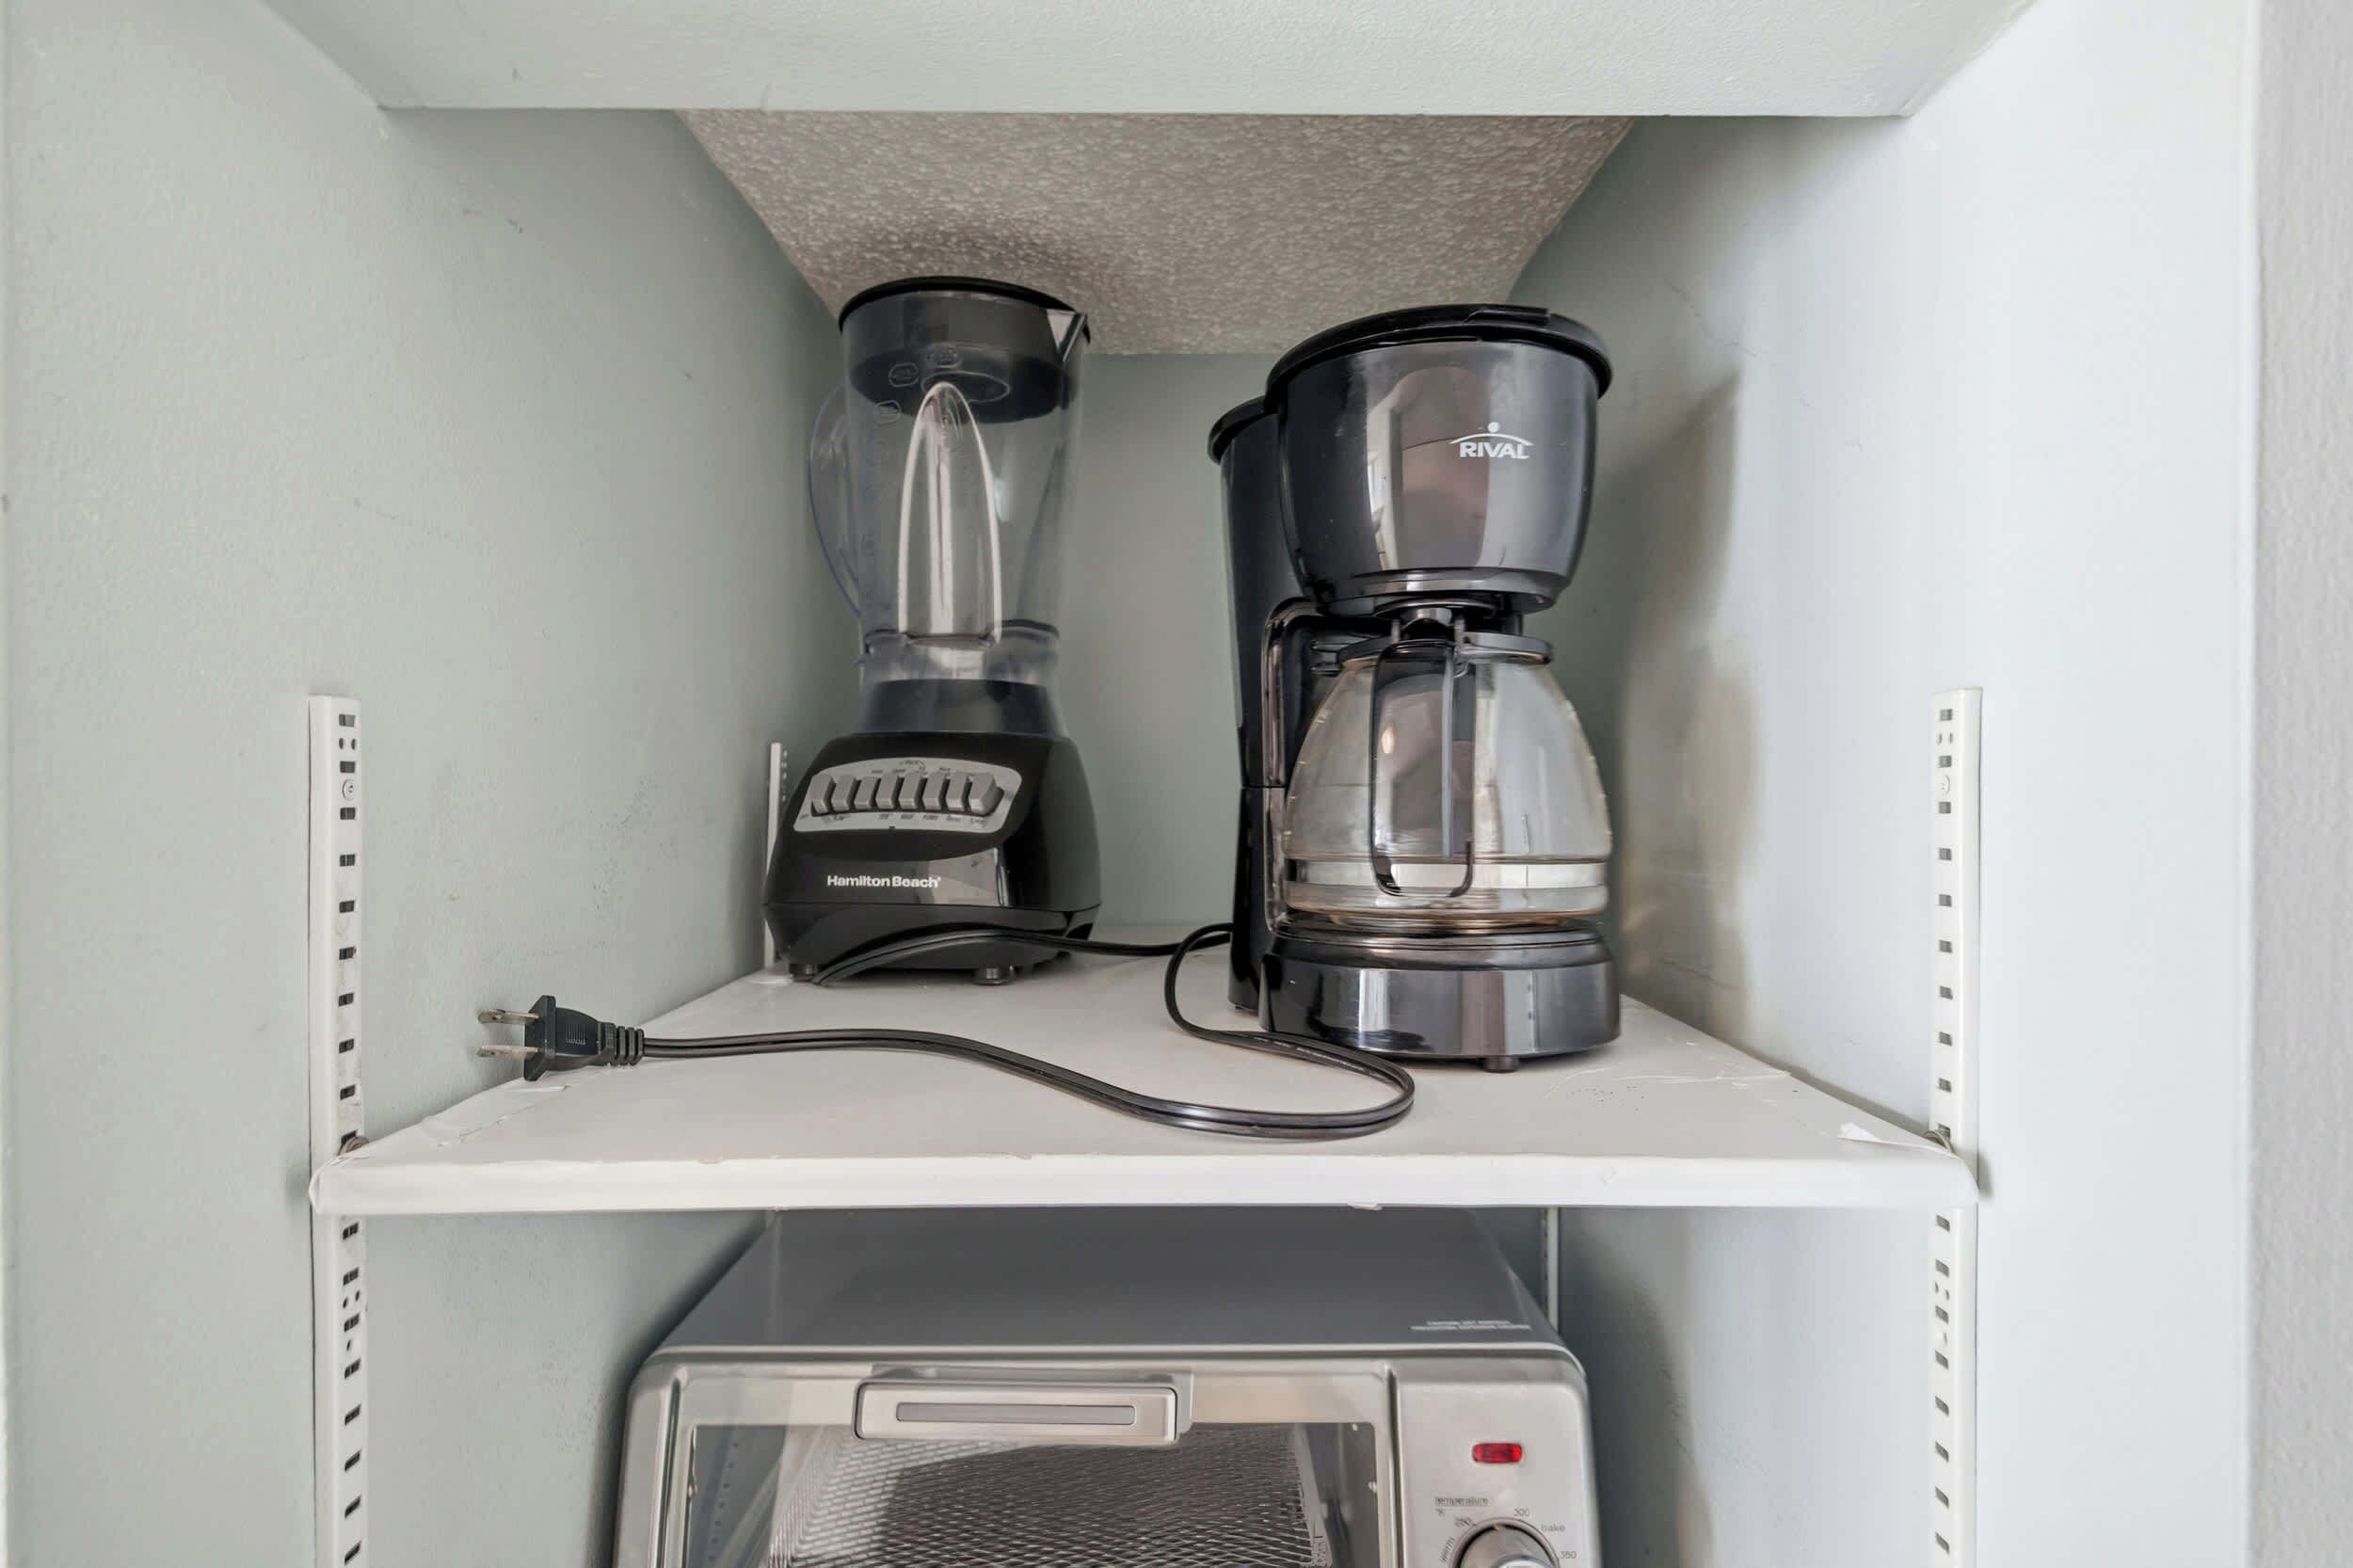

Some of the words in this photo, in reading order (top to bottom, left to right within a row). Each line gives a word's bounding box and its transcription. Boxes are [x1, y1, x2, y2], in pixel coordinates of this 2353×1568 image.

[1460, 441, 1529, 459] RIVAL
[827, 875, 890, 887] Hamilton
[891, 876, 939, 888] Beach
